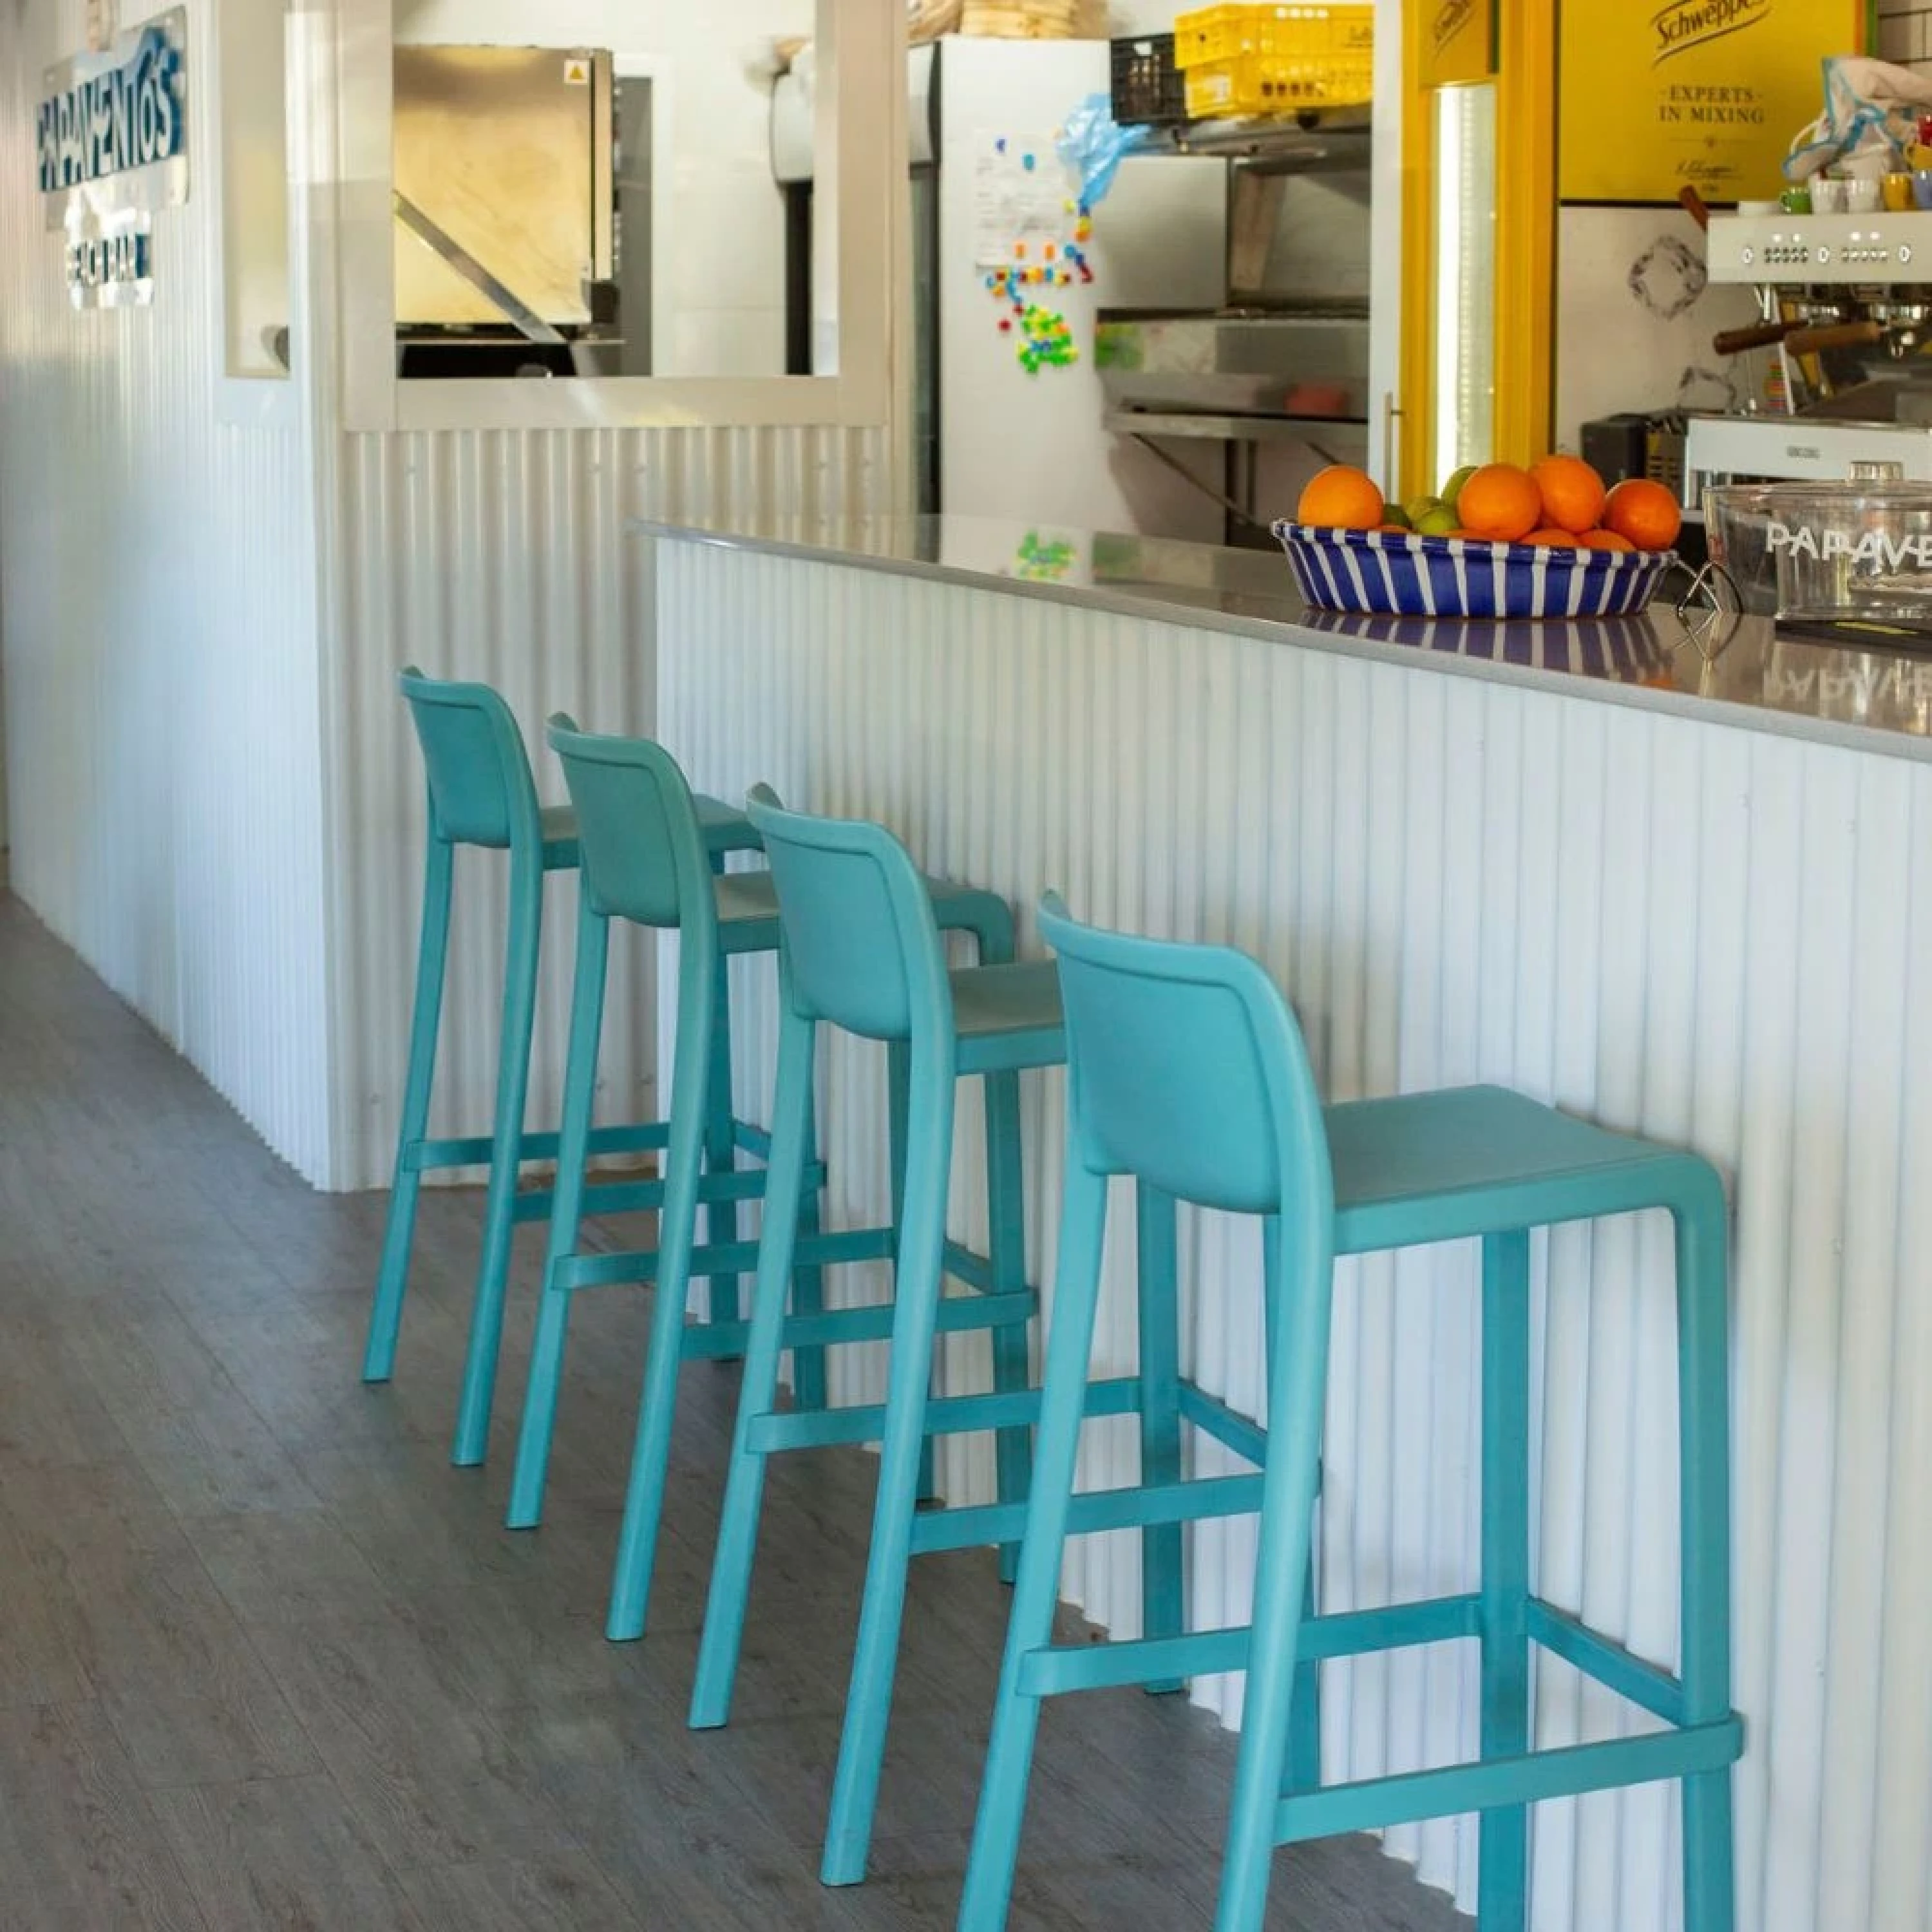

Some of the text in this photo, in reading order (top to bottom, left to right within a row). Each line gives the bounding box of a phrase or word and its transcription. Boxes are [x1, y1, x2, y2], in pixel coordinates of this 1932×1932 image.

[1671, 85, 1754, 103] EXPERTS
[1659, 106, 1764, 124] IN MIXING
